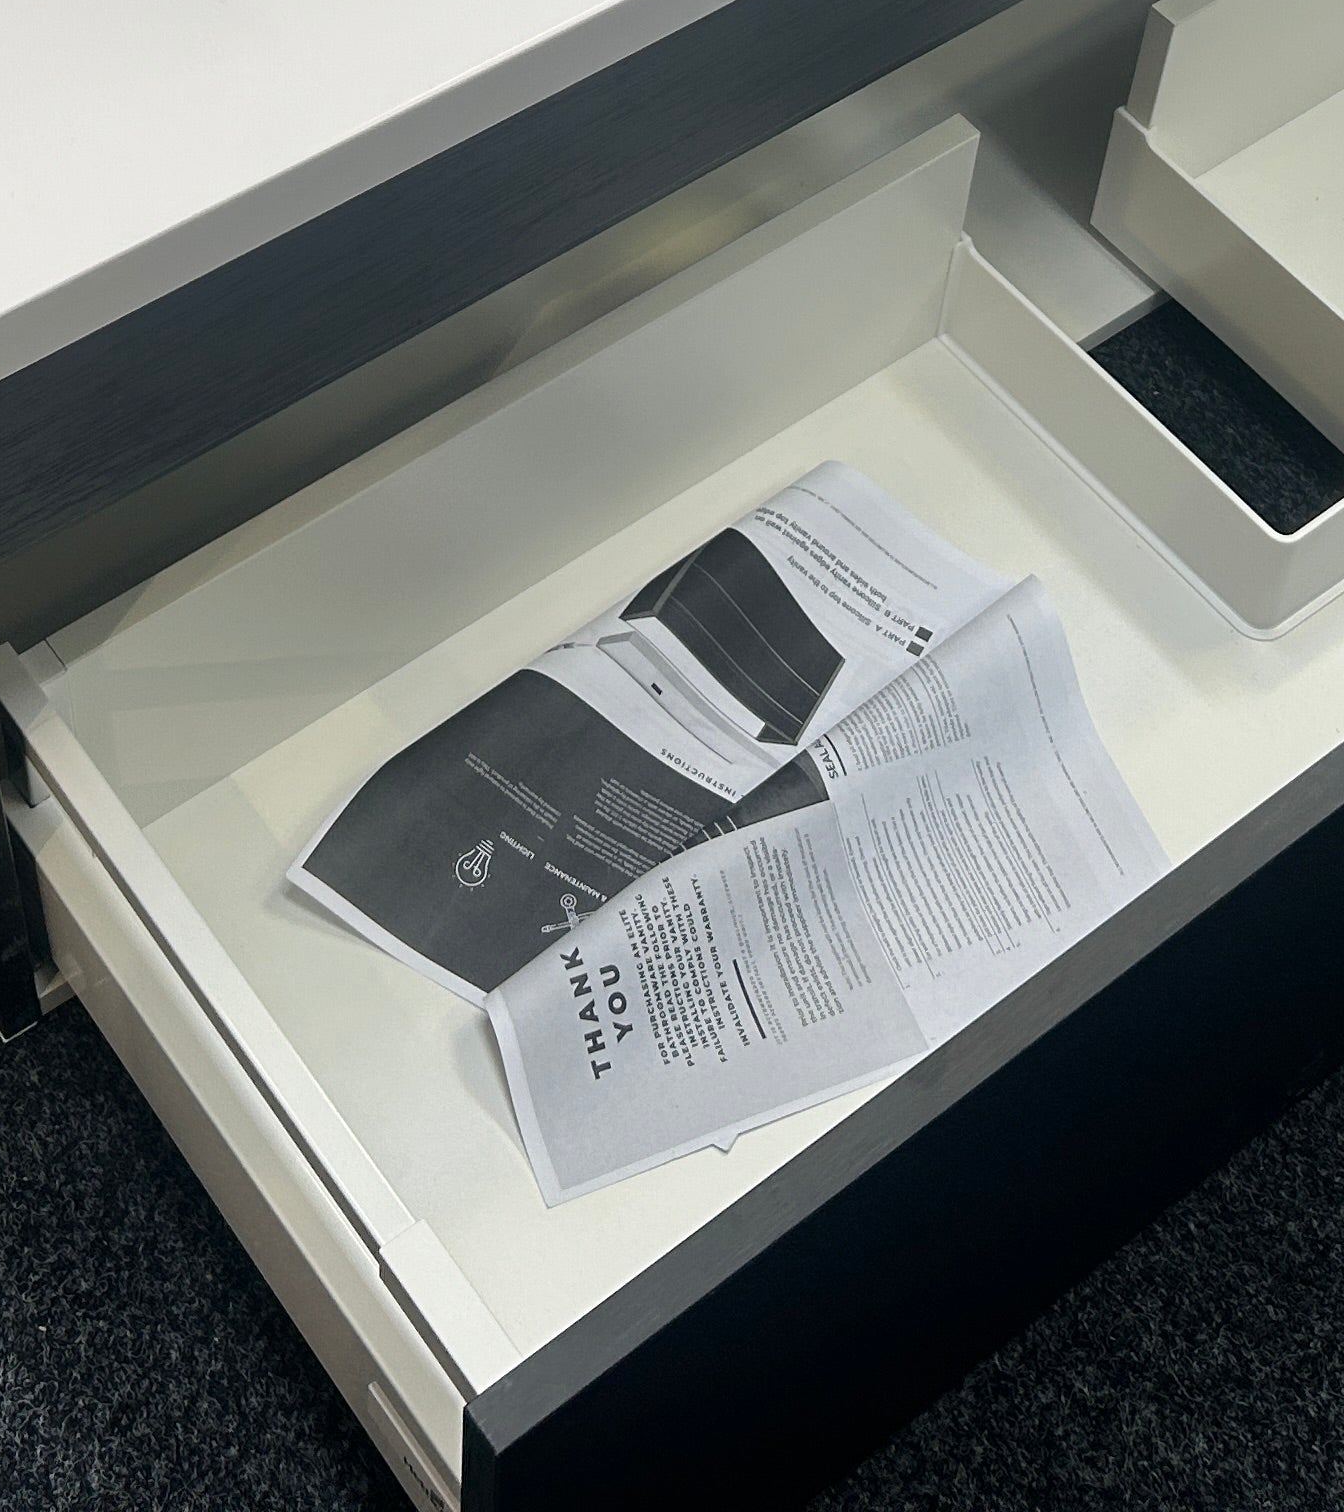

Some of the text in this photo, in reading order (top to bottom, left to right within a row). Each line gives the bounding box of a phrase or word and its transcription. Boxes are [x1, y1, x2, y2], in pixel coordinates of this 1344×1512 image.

[774, 511, 790, 525] top
[787, 519, 812, 541] vanity
[780, 527, 810, 553] against
[809, 537, 837, 562] around
[785, 554, 809, 576] vanity
[808, 548, 831, 571] edges
[833, 558, 850, 573] and
[806, 573, 821, 588] the
[819, 583, 829, 594] to
[828, 566, 852, 589] vanity
[827, 590, 842, 605] top
[850, 584, 882, 612] Silicone
[867, 585, 888, 603] both
[840, 600, 872, 626] Silicone
[889, 613, 916, 632] PART
[880, 628, 907, 647] PART
[659, 747, 737, 797] INSTRUCTIONS
[498, 830, 535, 860] LIGHTING
[758, 835, 771, 864] visible
[543, 861, 601, 899] MAINTENANCE
[689, 875, 714, 943] WARRANTY.
[742, 845, 809, 1027] Prior to installation it is important to inspect
[749, 838, 818, 1023] the unit and ensure no damage has occurred
[782, 923, 793, 941] has
[659, 898, 710, 1048] INSTALLING YOUR VANITY.
[661, 875, 728, 1063] FAILURE TO COMPLY WITH THESE
[682, 902, 725, 1030] INSTRUCTIONS COULD
[709, 945, 724, 978] YOUR
[788, 941, 806, 976] damage
[617, 908, 671, 1065] FOR PURCHASING AN ELITE
[629, 907, 680, 1058] BATHROOMWARE VANITY.
[634, 893, 695, 1067] PLEASE READ THE FOLLOWING
[650, 904, 698, 1048] INSTRUCTIONS PRIOR TO
[559, 946, 612, 1080] THANK
[598, 963, 635, 1043] YOU
[718, 980, 751, 1046] INVALIDATE
[818, 1010, 827, 1020] in
